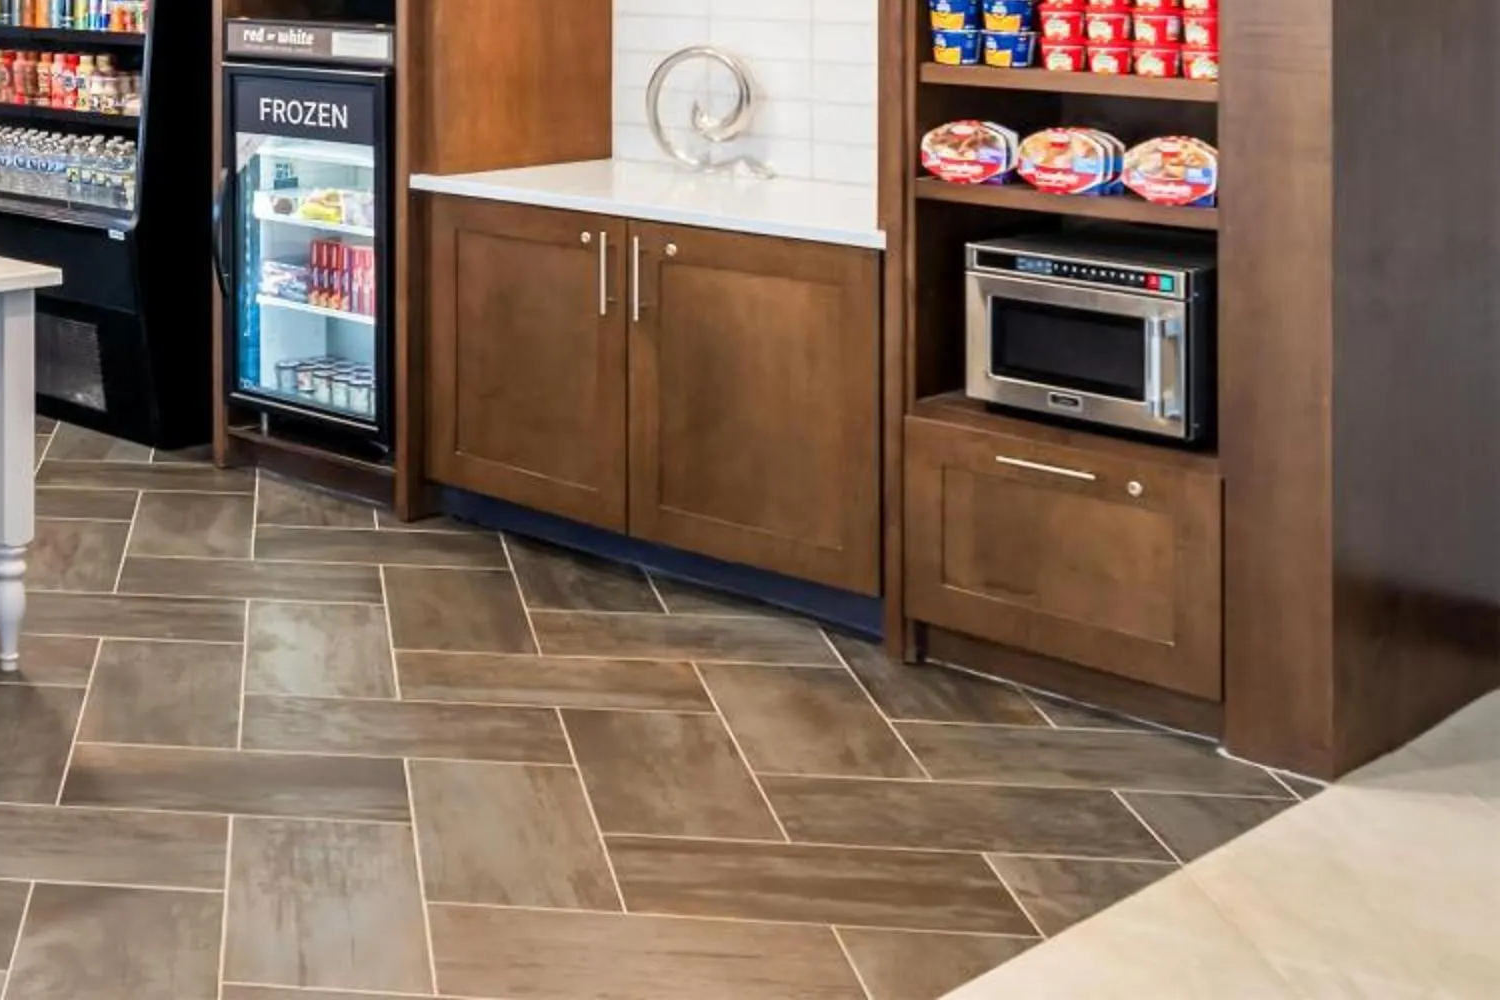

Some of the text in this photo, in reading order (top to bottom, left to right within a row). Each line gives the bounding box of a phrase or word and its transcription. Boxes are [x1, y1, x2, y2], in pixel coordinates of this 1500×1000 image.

[243, 28, 264, 44] red
[277, 29, 315, 46] white
[259, 97, 349, 129] FROZEN
